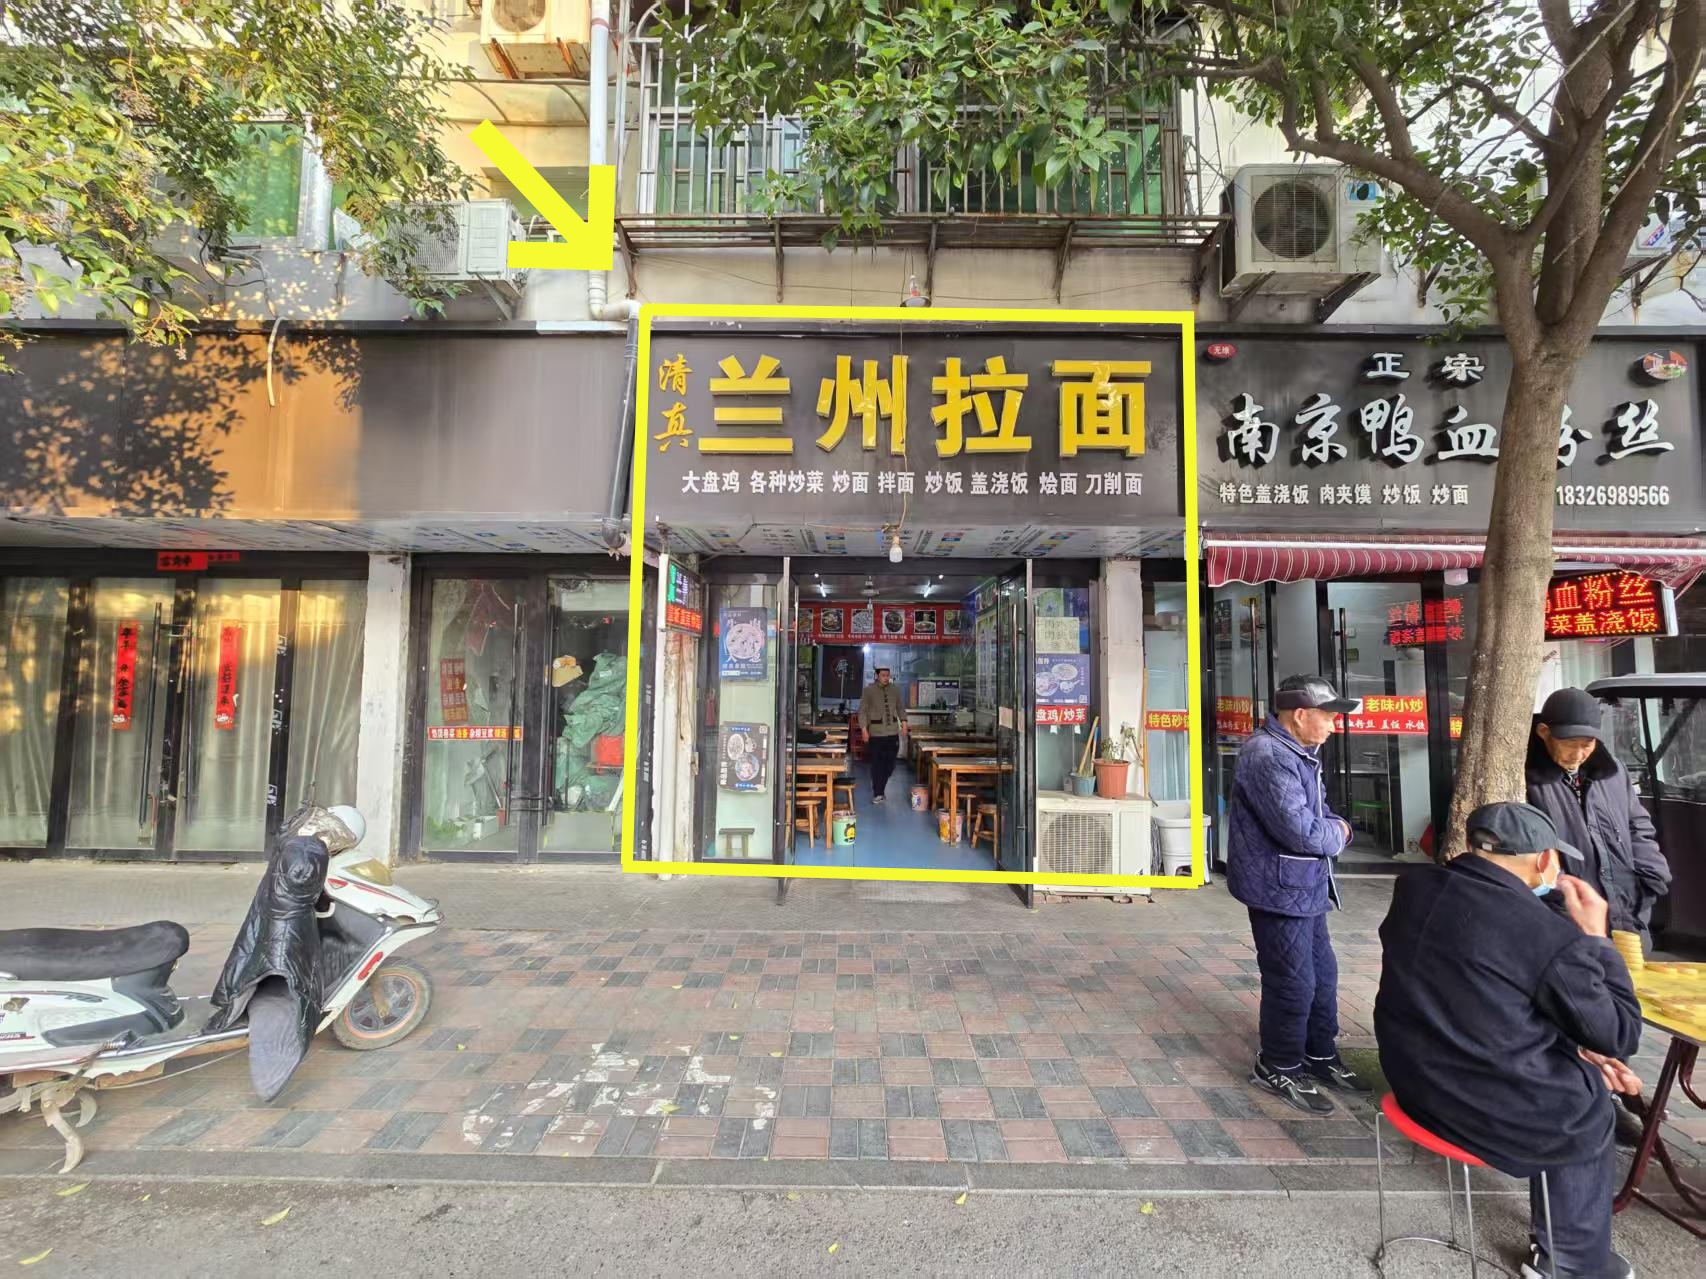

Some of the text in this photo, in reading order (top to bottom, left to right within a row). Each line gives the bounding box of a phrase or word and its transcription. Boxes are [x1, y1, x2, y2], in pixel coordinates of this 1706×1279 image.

[1366, 352, 1485, 382] 正宗
[653, 353, 694, 452] 清真
[698, 354, 1152, 458] 兰州拉面
[681, 470, 1144, 496] 大盘鸡 各种炒菜 炒面 拌面 炒饭 盖浇饭 烩面 刀削面
[1219, 483, 1670, 505] 特色盖浇饭 肉夹馍 炒饭 炒面 18326989566
[1545, 574, 1654, 613] 血粉丝
[1545, 608, 1658, 635] 菜盖浇饭
[1366, 698, 1424, 713] 老味小炒
